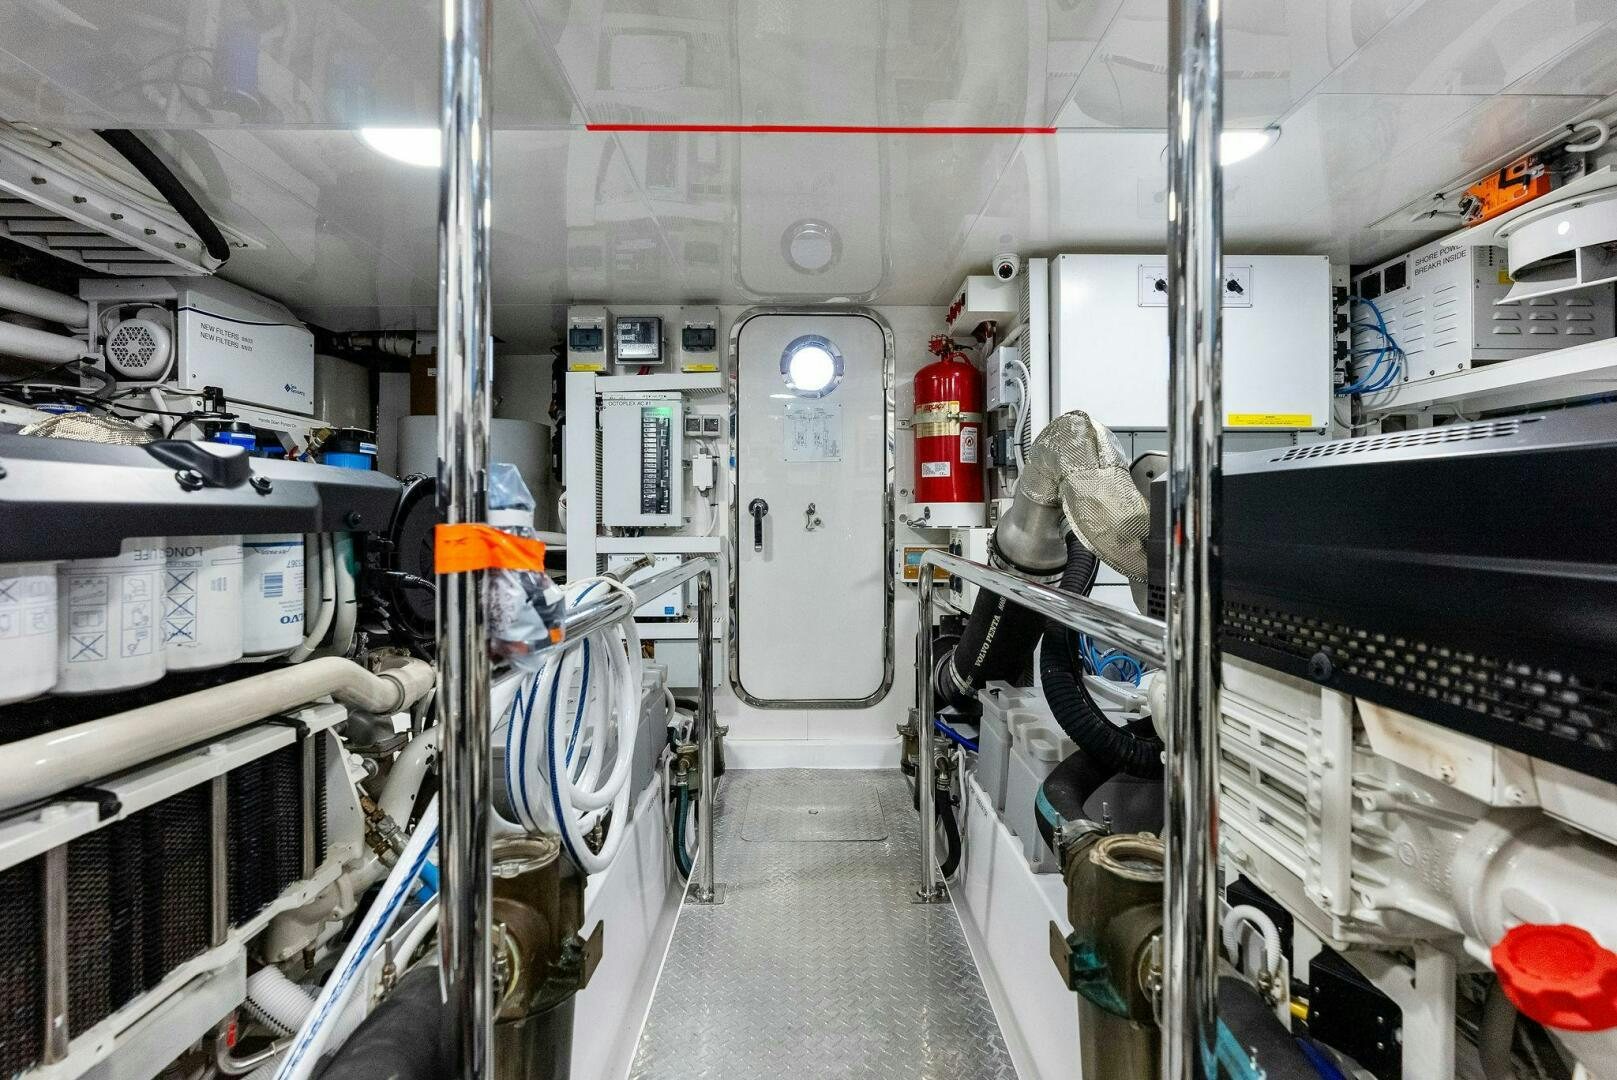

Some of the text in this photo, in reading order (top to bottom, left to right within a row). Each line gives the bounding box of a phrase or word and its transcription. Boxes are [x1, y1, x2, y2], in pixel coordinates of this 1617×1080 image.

[1414, 260, 1442, 276] BREAKR
[1442, 249, 1467, 265] INSIDE
[1415, 251, 1439, 267] SHORE
[200, 322, 215, 333] NEW
[215, 328, 240, 341] FILTERS
[200, 331, 215, 341] NEW
[215, 336, 239, 349] FILTERS
[166, 546, 203, 558] LONG
[974, 614, 1001, 667] VOLVO PENTA
